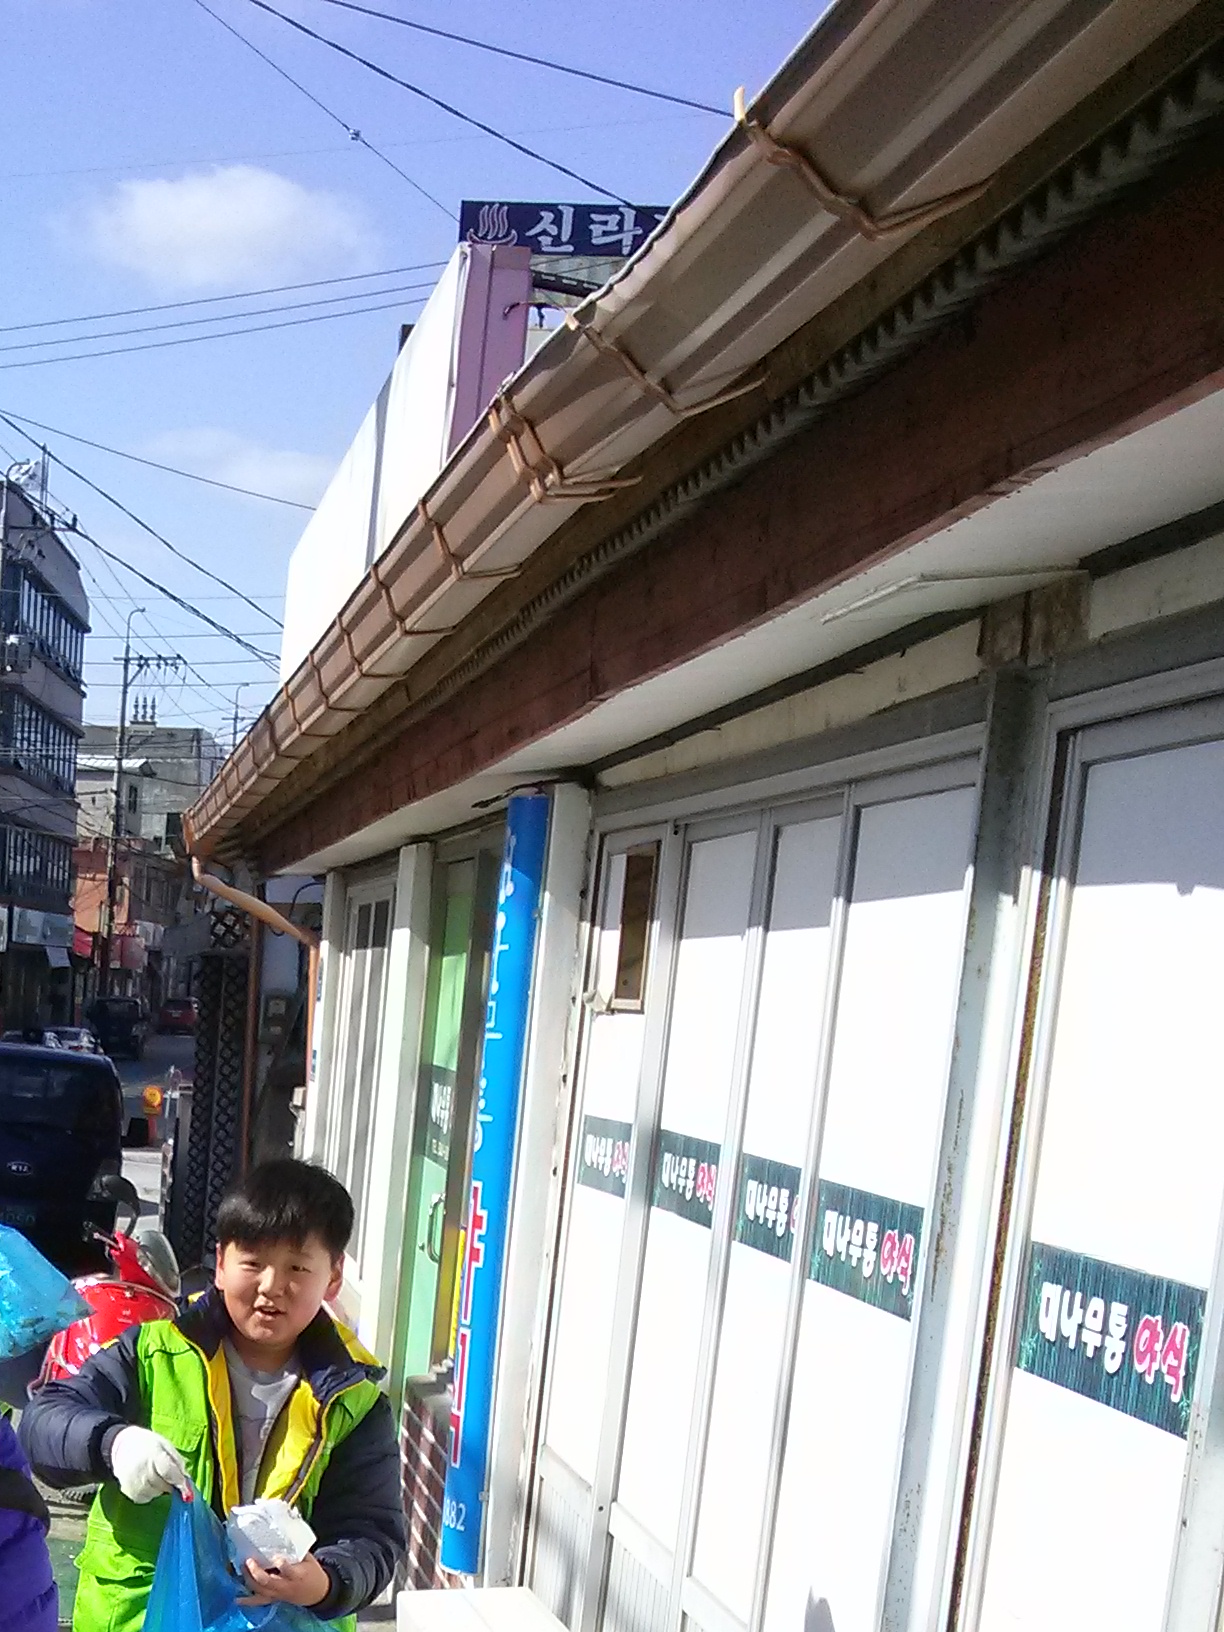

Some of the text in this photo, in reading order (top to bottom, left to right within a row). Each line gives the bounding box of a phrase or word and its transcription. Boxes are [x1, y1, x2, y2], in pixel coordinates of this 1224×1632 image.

[526, 204, 669, 255] 신라
[880, 1229, 915, 1296] 야식
[1038, 1281, 1190, 1403] 대나무통 야식
